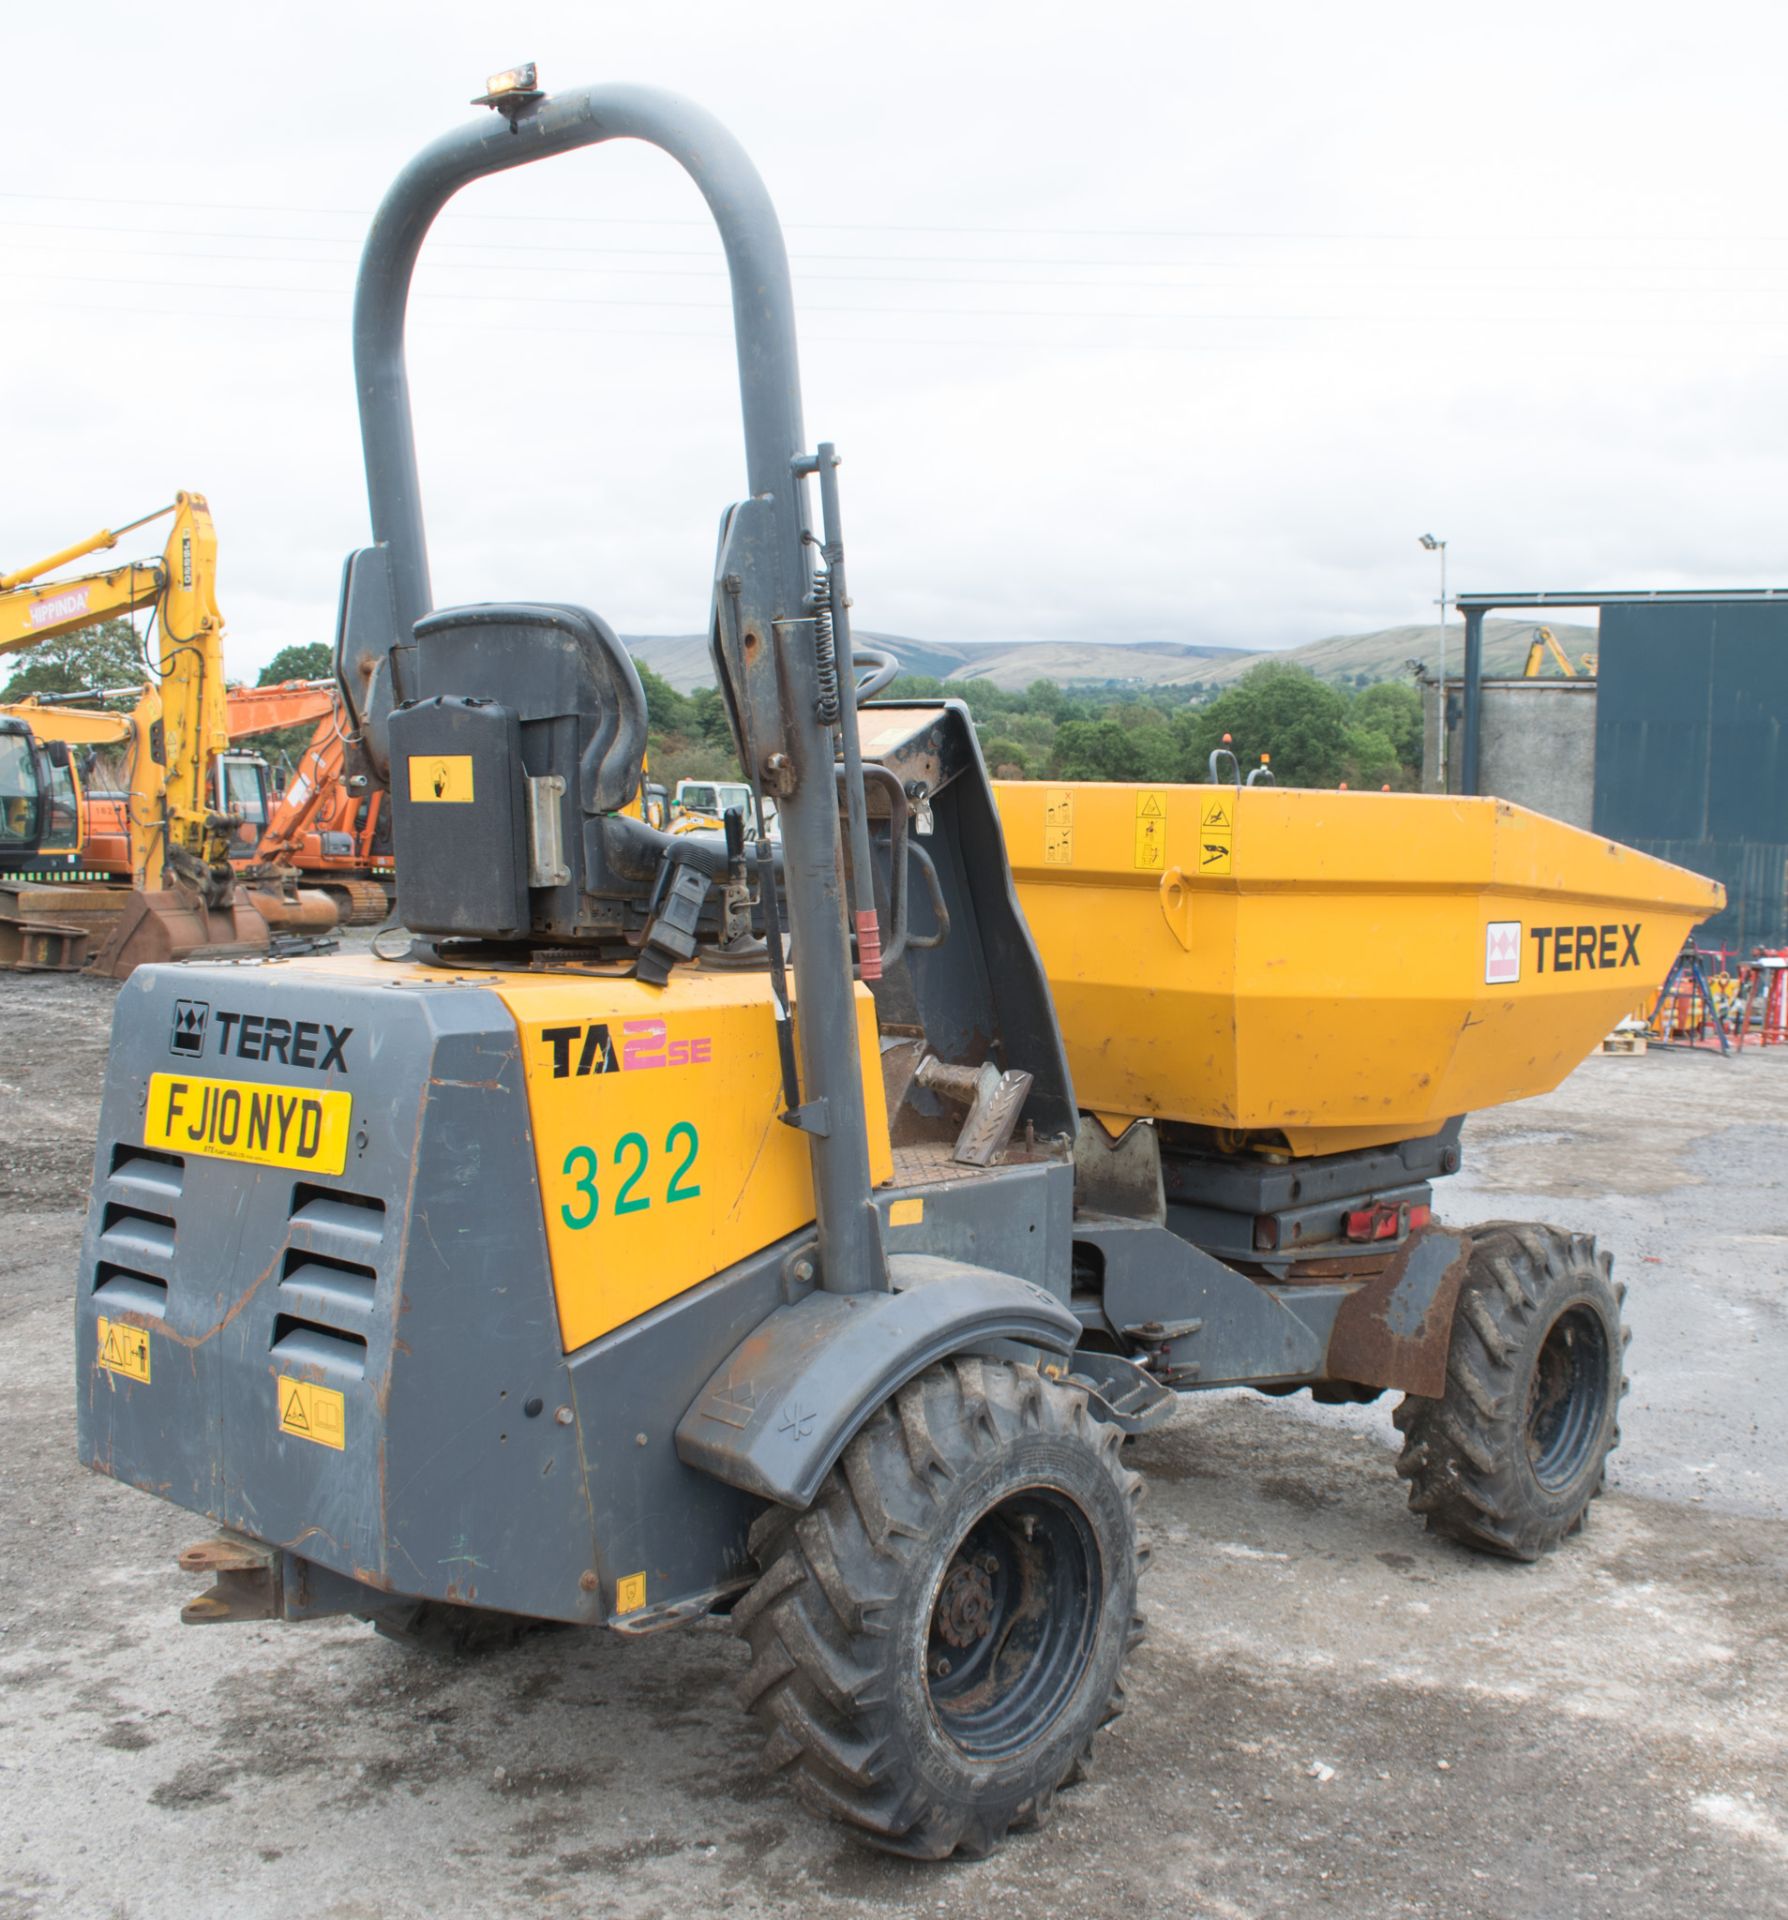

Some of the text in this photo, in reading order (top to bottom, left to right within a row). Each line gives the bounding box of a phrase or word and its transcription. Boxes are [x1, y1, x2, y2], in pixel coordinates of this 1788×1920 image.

[23, 591, 89, 627] HIPPINDA
[1530, 923, 1642, 973] TEREX
[215, 1011, 354, 1073] TEREX
[247, 1091, 323, 1159] NYD
[560, 1120, 701, 1230] 322
